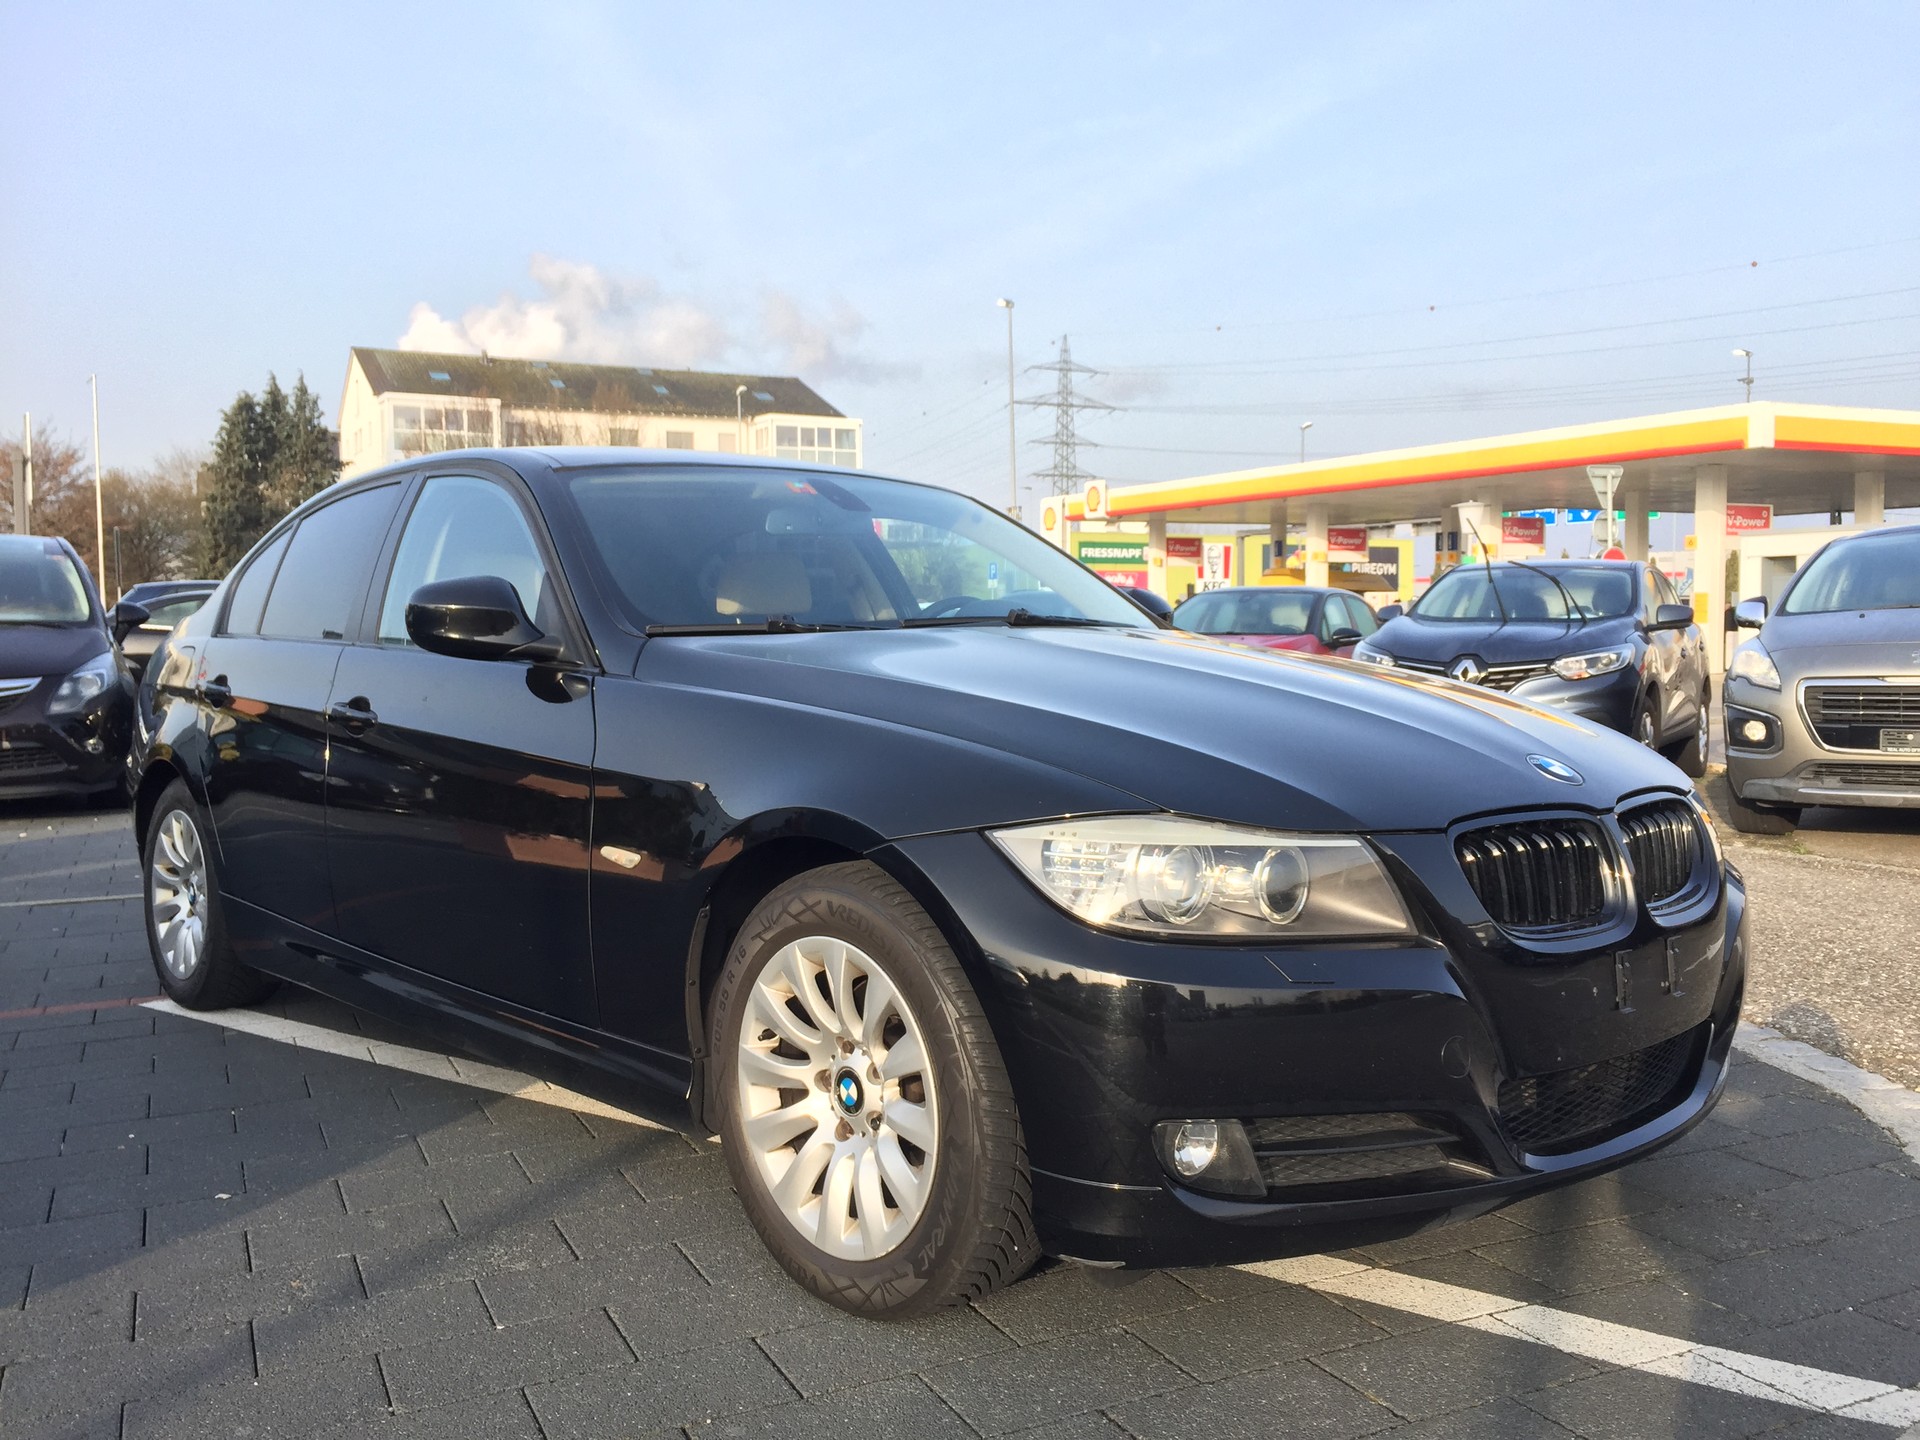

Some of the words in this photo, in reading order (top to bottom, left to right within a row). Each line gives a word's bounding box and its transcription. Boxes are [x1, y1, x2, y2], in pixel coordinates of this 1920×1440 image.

[1727, 515, 1766, 527] V-Power
[1504, 526, 1540, 536] V-Power
[1330, 536, 1363, 545] V-Power
[1081, 547, 1142, 559] FRESSNAPF
[1351, 562, 1397, 575] PUREGYM
[734, 944, 748, 965] 16
